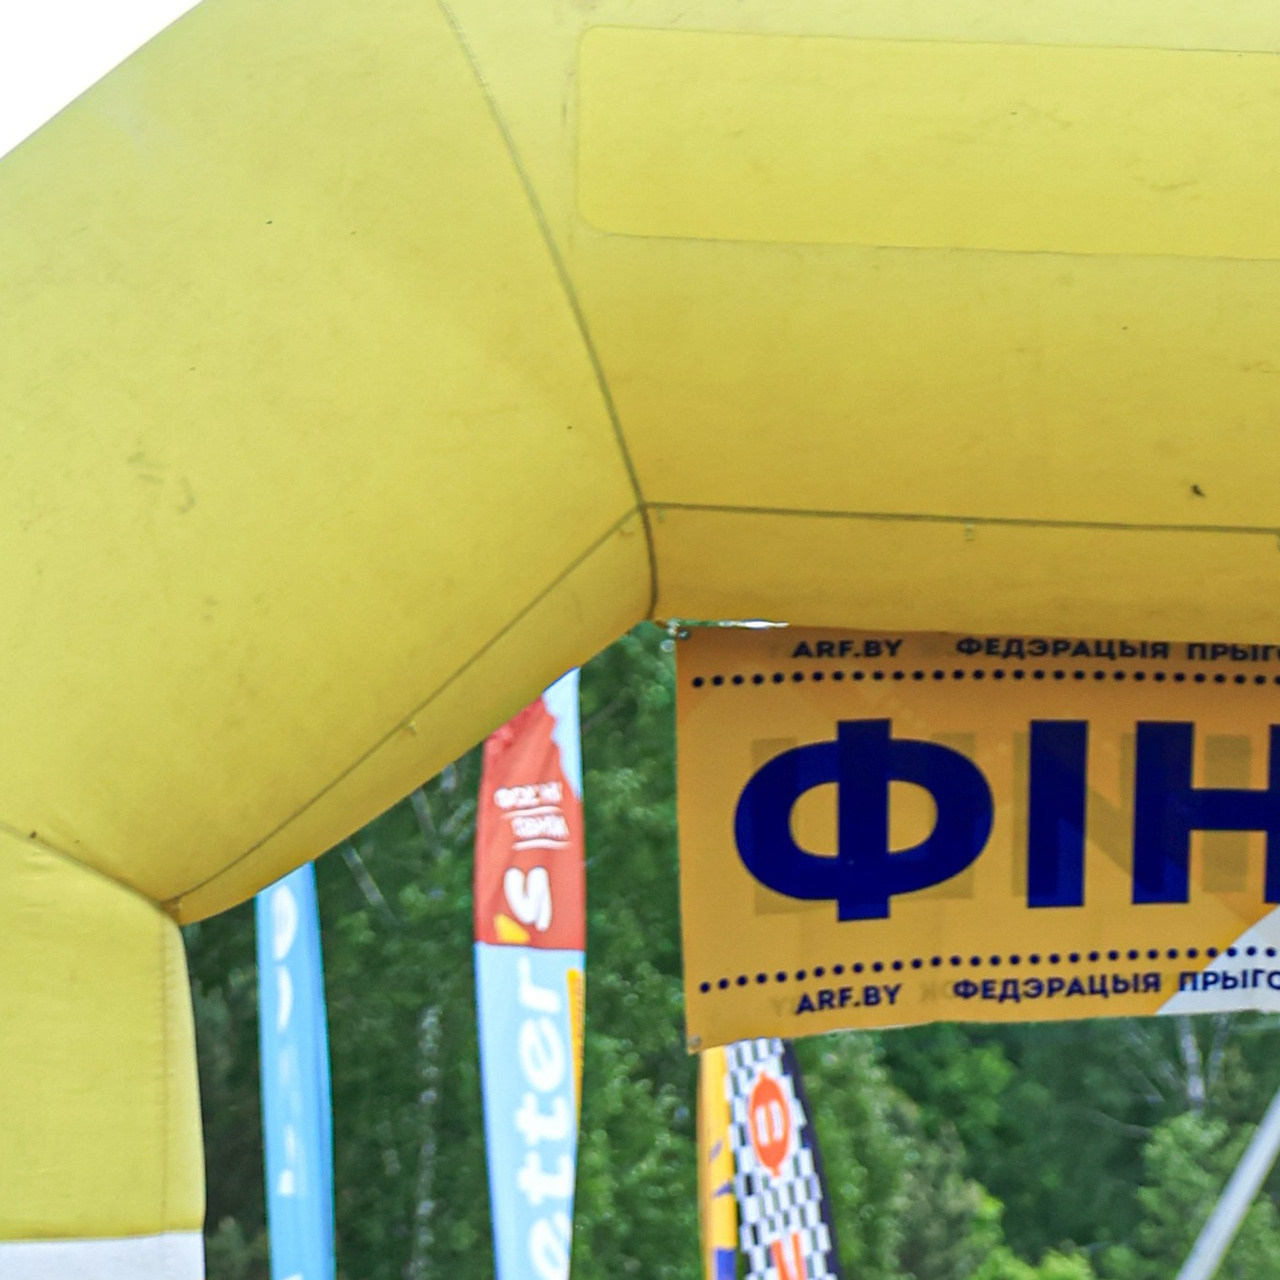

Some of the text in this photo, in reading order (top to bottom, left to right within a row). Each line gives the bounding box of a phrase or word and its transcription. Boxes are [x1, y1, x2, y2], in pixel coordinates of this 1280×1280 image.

[791, 639, 903, 660] ARF.BY
[955, 636, 1170, 661] ФЕДЭРАЦЫЯ
[795, 983, 903, 1015] ARF.BY
[952, 971, 1162, 1002] ФЕДЭРАЦЫЯ
